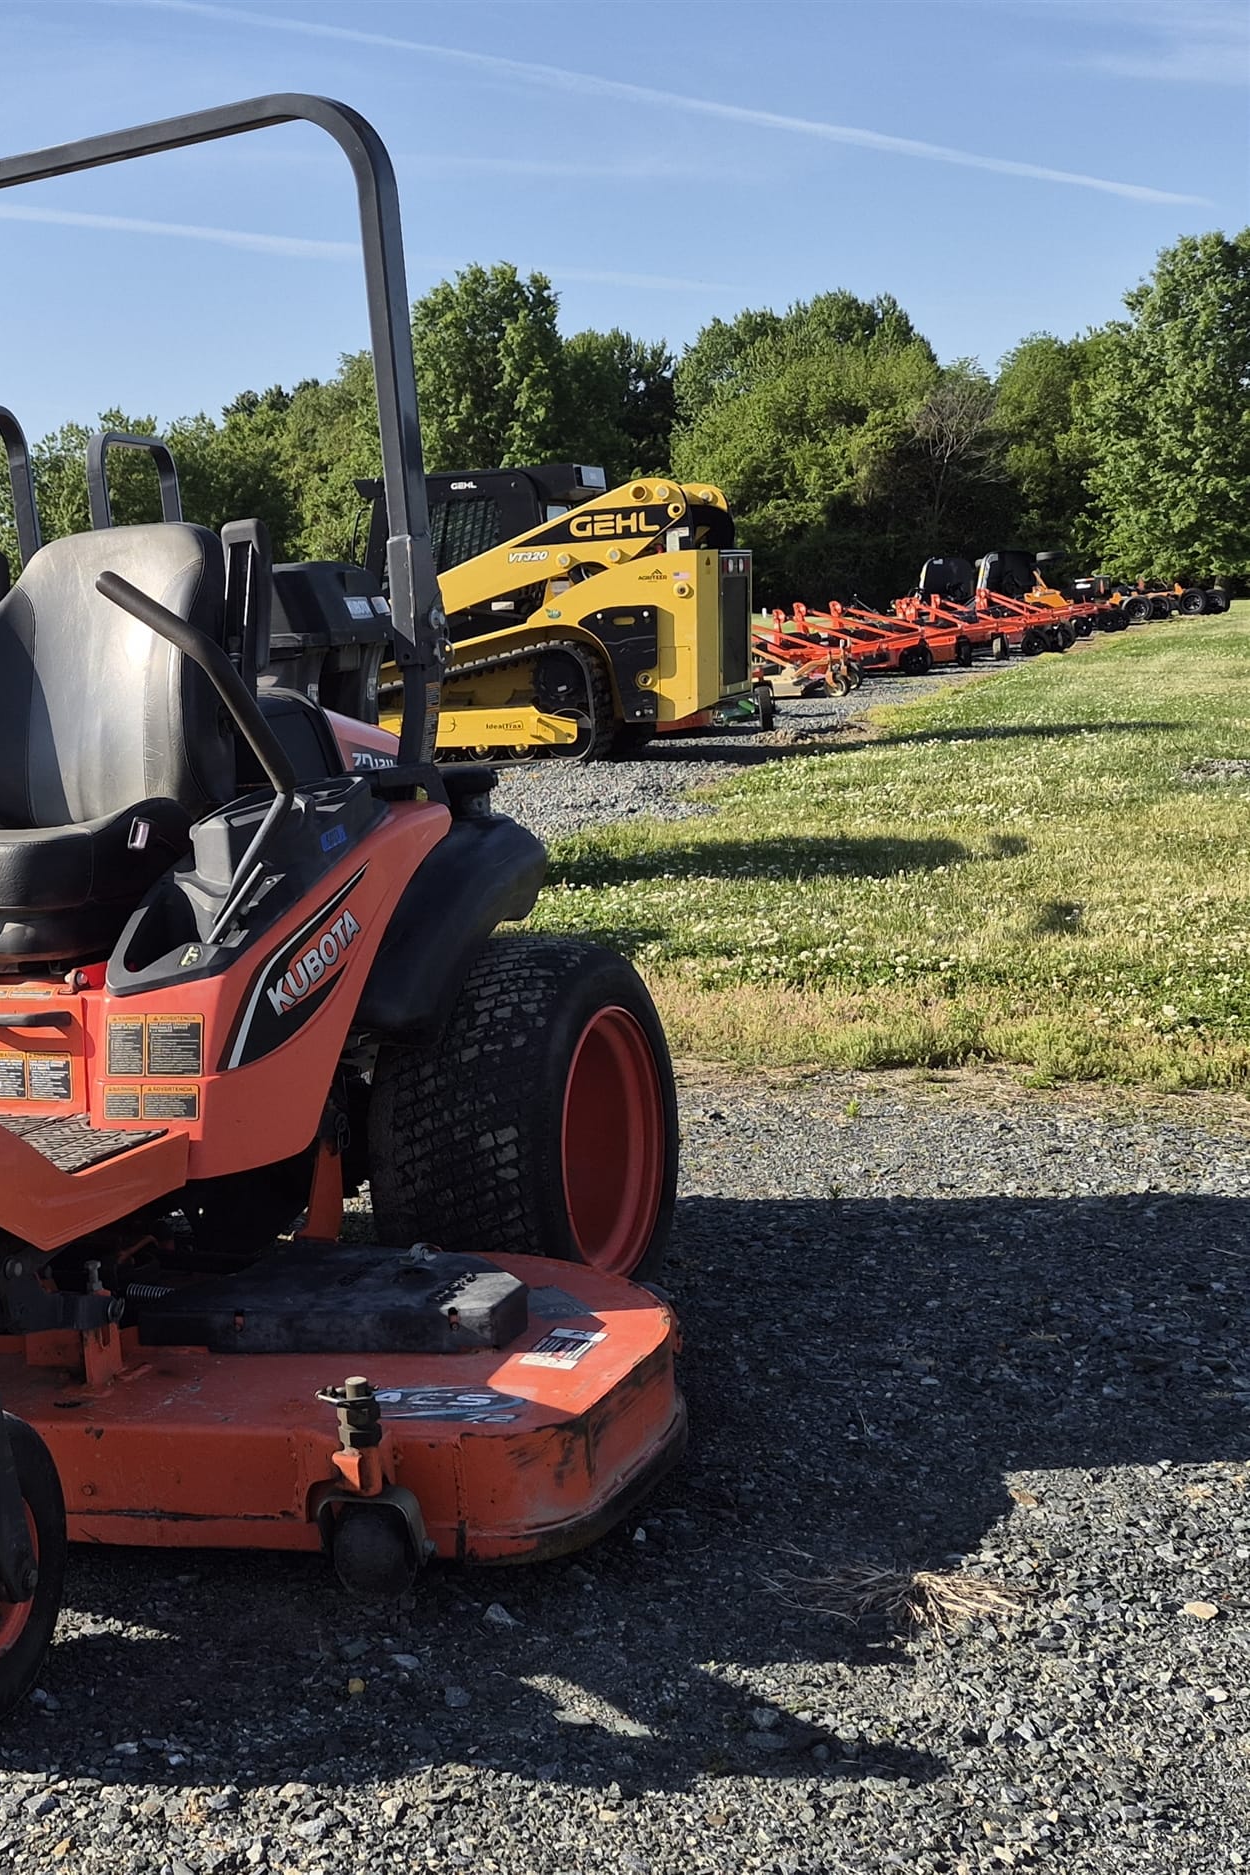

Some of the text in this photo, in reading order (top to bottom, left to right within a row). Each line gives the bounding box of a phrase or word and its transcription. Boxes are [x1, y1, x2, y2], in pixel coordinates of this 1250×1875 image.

[450, 481, 478, 490] GEHL
[569, 511, 660, 537] GEHL
[508, 551, 548, 563] VT320
[266, 908, 361, 1017] KUBOTA
